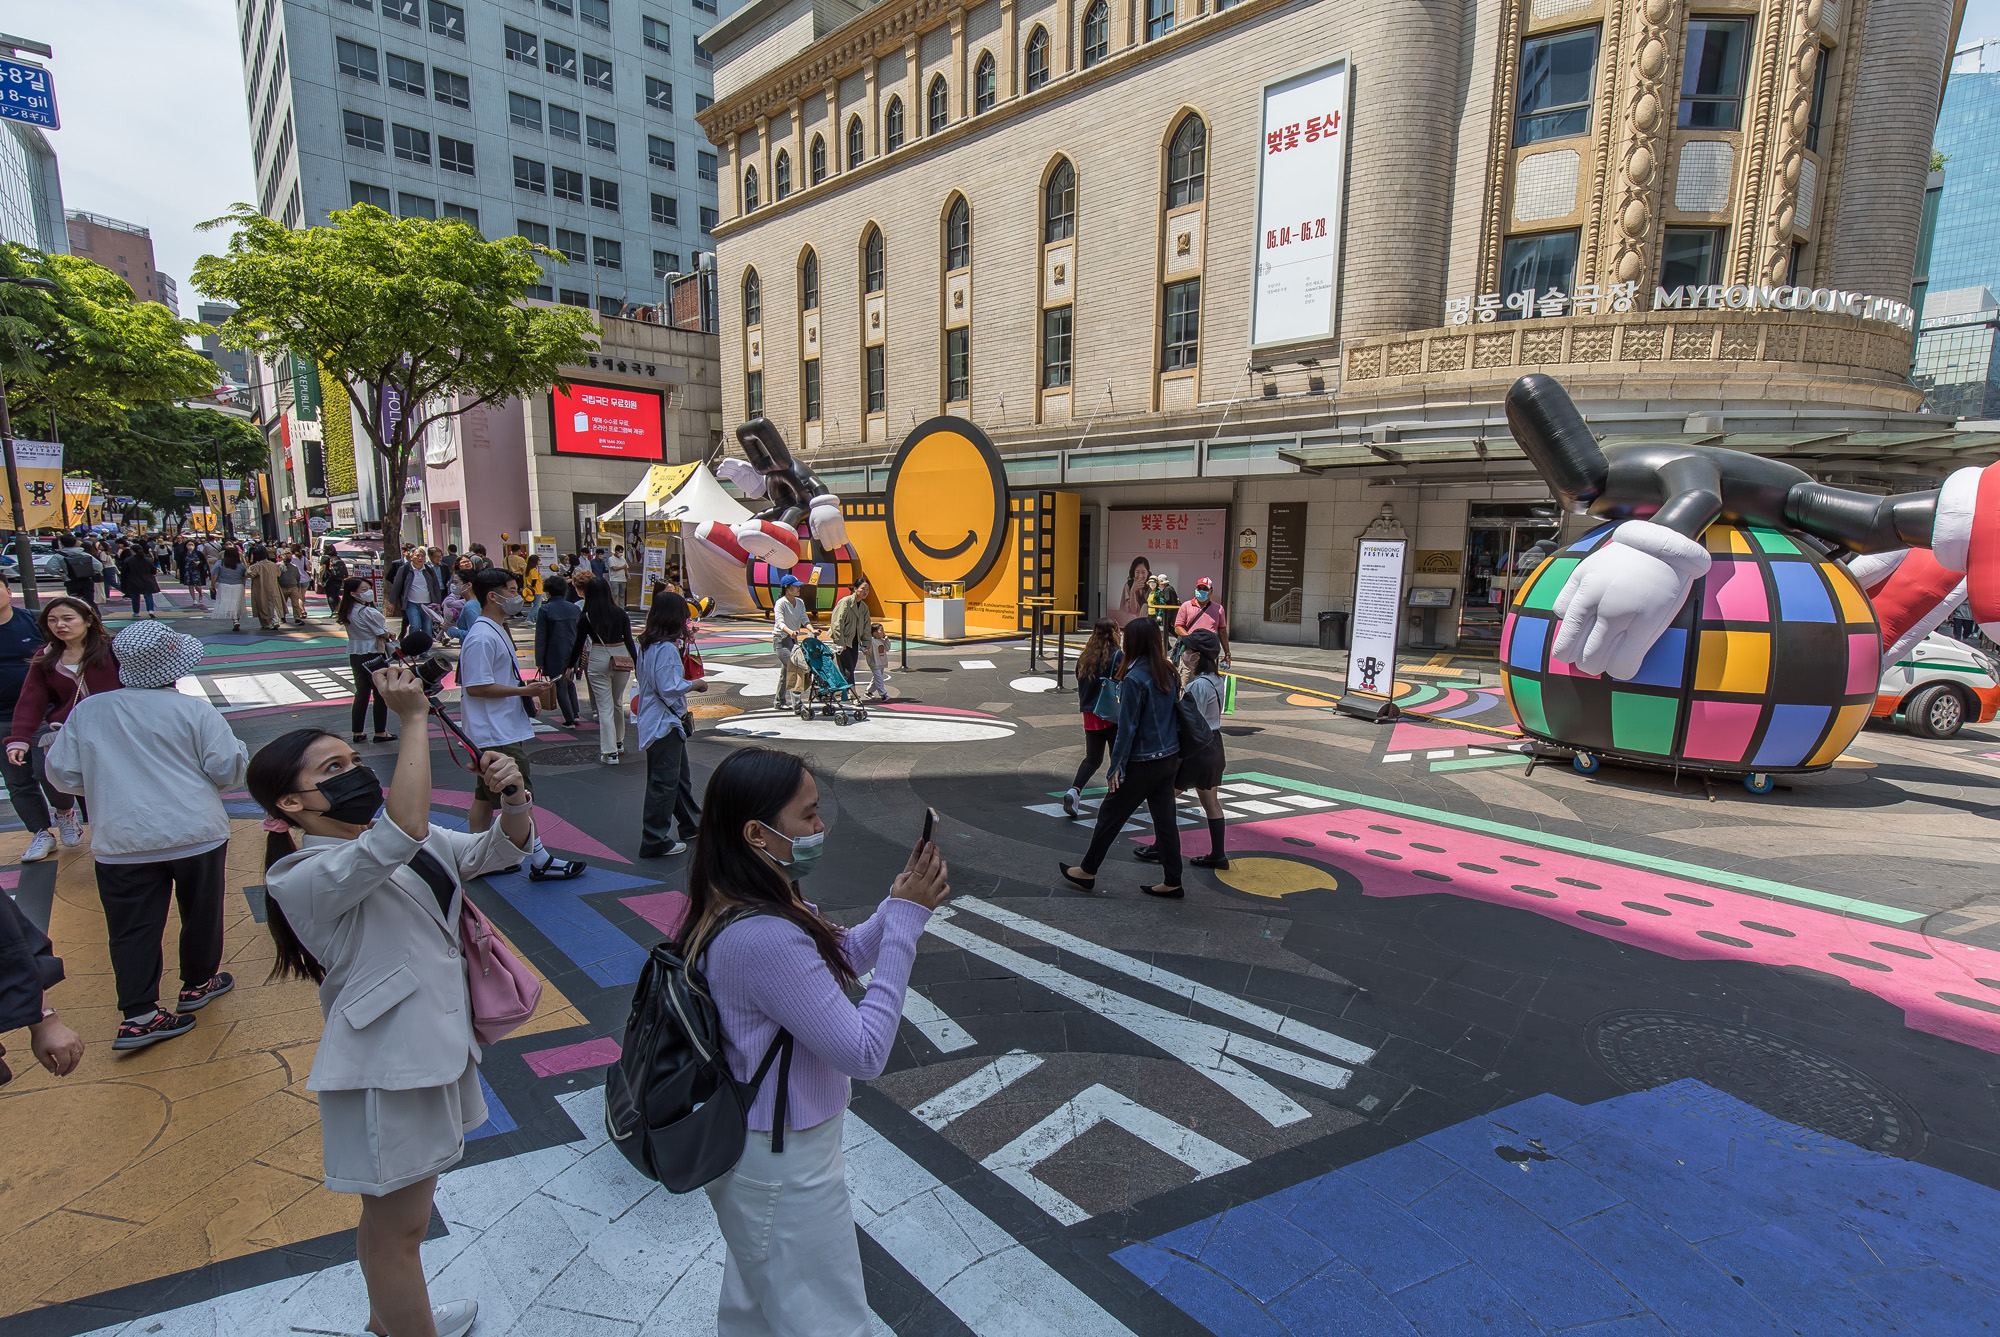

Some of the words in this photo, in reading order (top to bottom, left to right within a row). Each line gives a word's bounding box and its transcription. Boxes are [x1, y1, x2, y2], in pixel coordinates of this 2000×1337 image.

[9, 89, 48, 108] 8-gil
[1267, 122, 1300, 155] 벚꽃
[1304, 110, 1340, 143] 동산
[1445, 280, 1639, 325] 명동예술극장
[1653, 284, 1863, 316] MYEONGDONG
[588, 356, 656, 377] 동예술극장
[299, 373, 310, 413] REPUBLIC
[581, 394, 609, 406] 국립극단
[611, 398, 637, 410] 무료회원
[1141, 513, 1163, 531] 벚꽃
[1165, 513, 1188, 531] 동산
